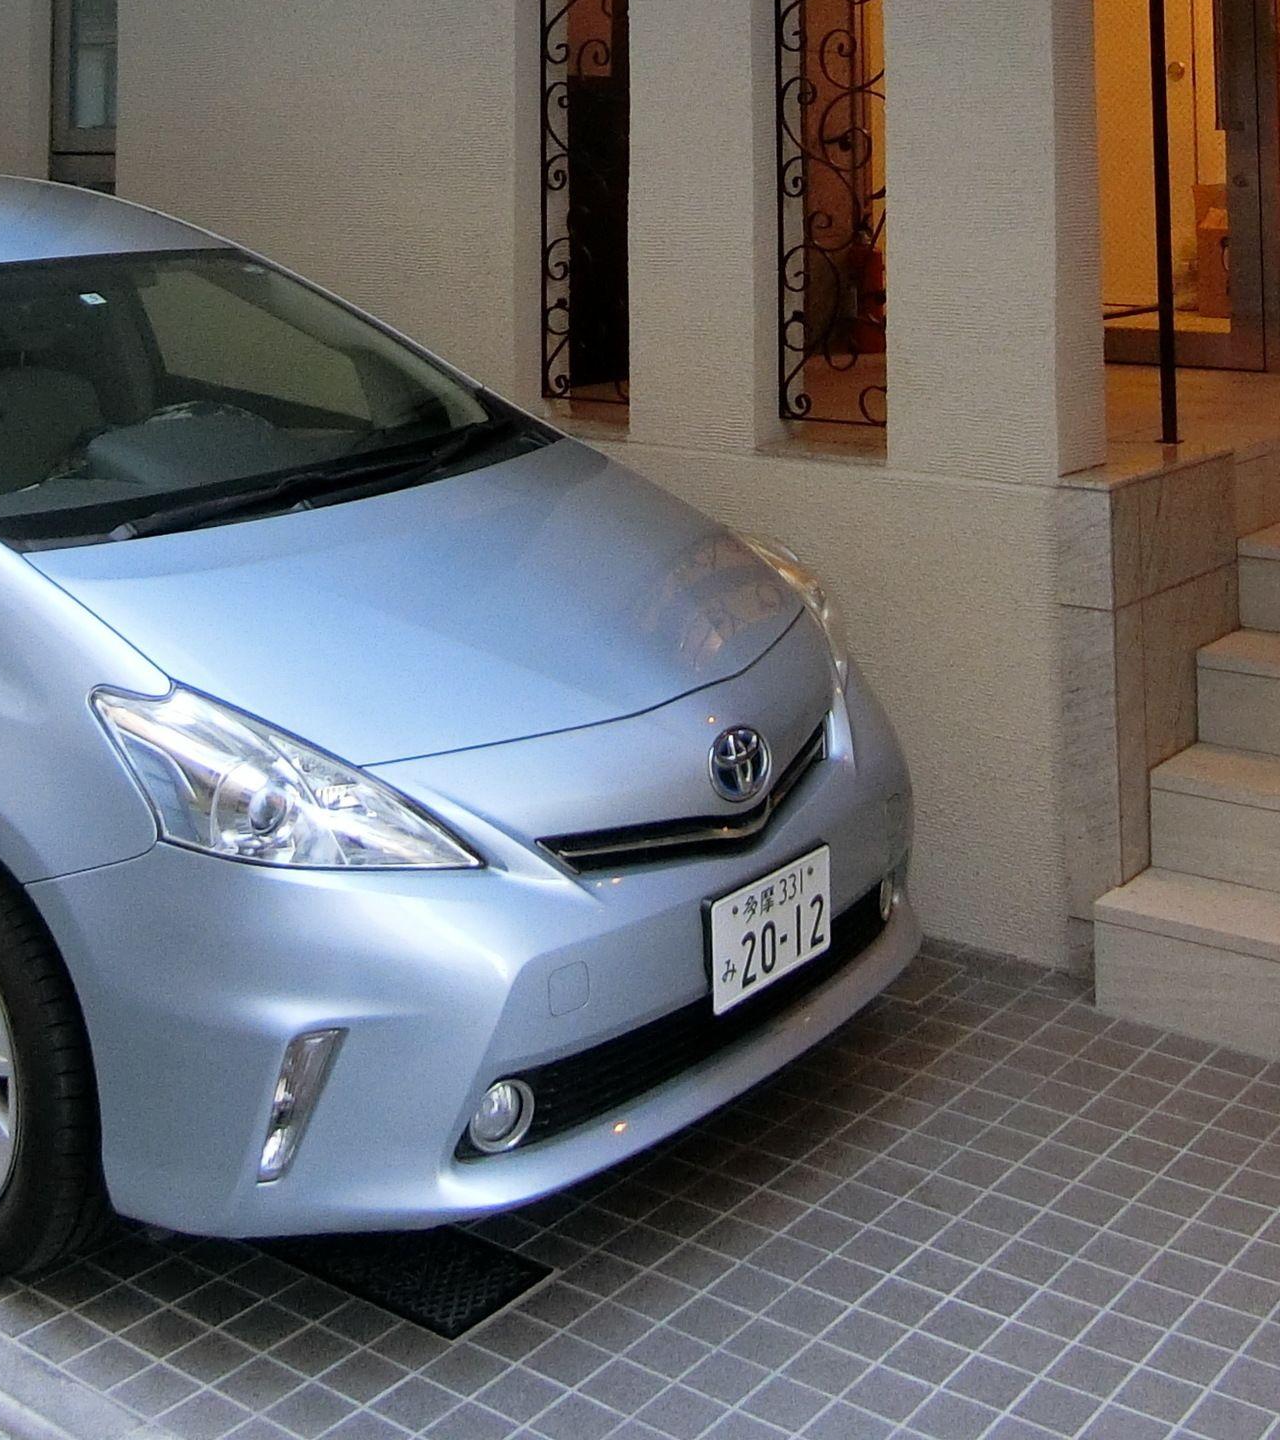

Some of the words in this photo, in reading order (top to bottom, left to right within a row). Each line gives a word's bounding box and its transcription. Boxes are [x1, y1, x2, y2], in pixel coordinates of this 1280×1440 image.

[743, 885, 775, 923] 多摩
[778, 868, 804, 906] 331
[722, 959, 738, 983] み
[741, 893, 825, 990] 20-12
